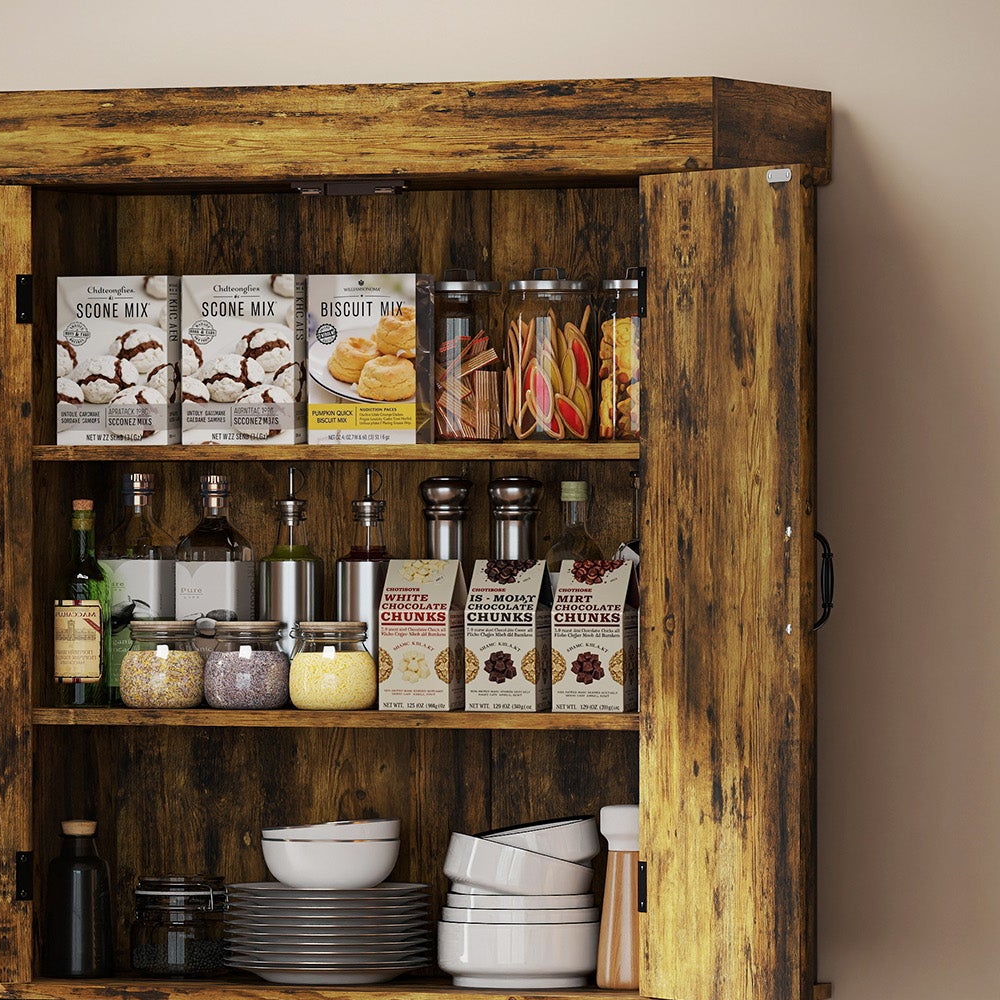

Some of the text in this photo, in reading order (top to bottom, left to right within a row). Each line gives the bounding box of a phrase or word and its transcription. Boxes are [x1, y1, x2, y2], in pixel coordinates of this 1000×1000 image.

[76, 303, 149, 318] SCONE MIX
[202, 302, 275, 317] SCONE MIX
[321, 302, 404, 317] BISCUIT MIX
[384, 594, 429, 602] WHITE
[556, 595, 593, 603] MIRT
[468, 603, 534, 611] CHOCOLATE
[380, 611, 446, 622] CHUNKS
[467, 612, 533, 623] CHUNKS
[553, 612, 620, 623] CHUNKS
